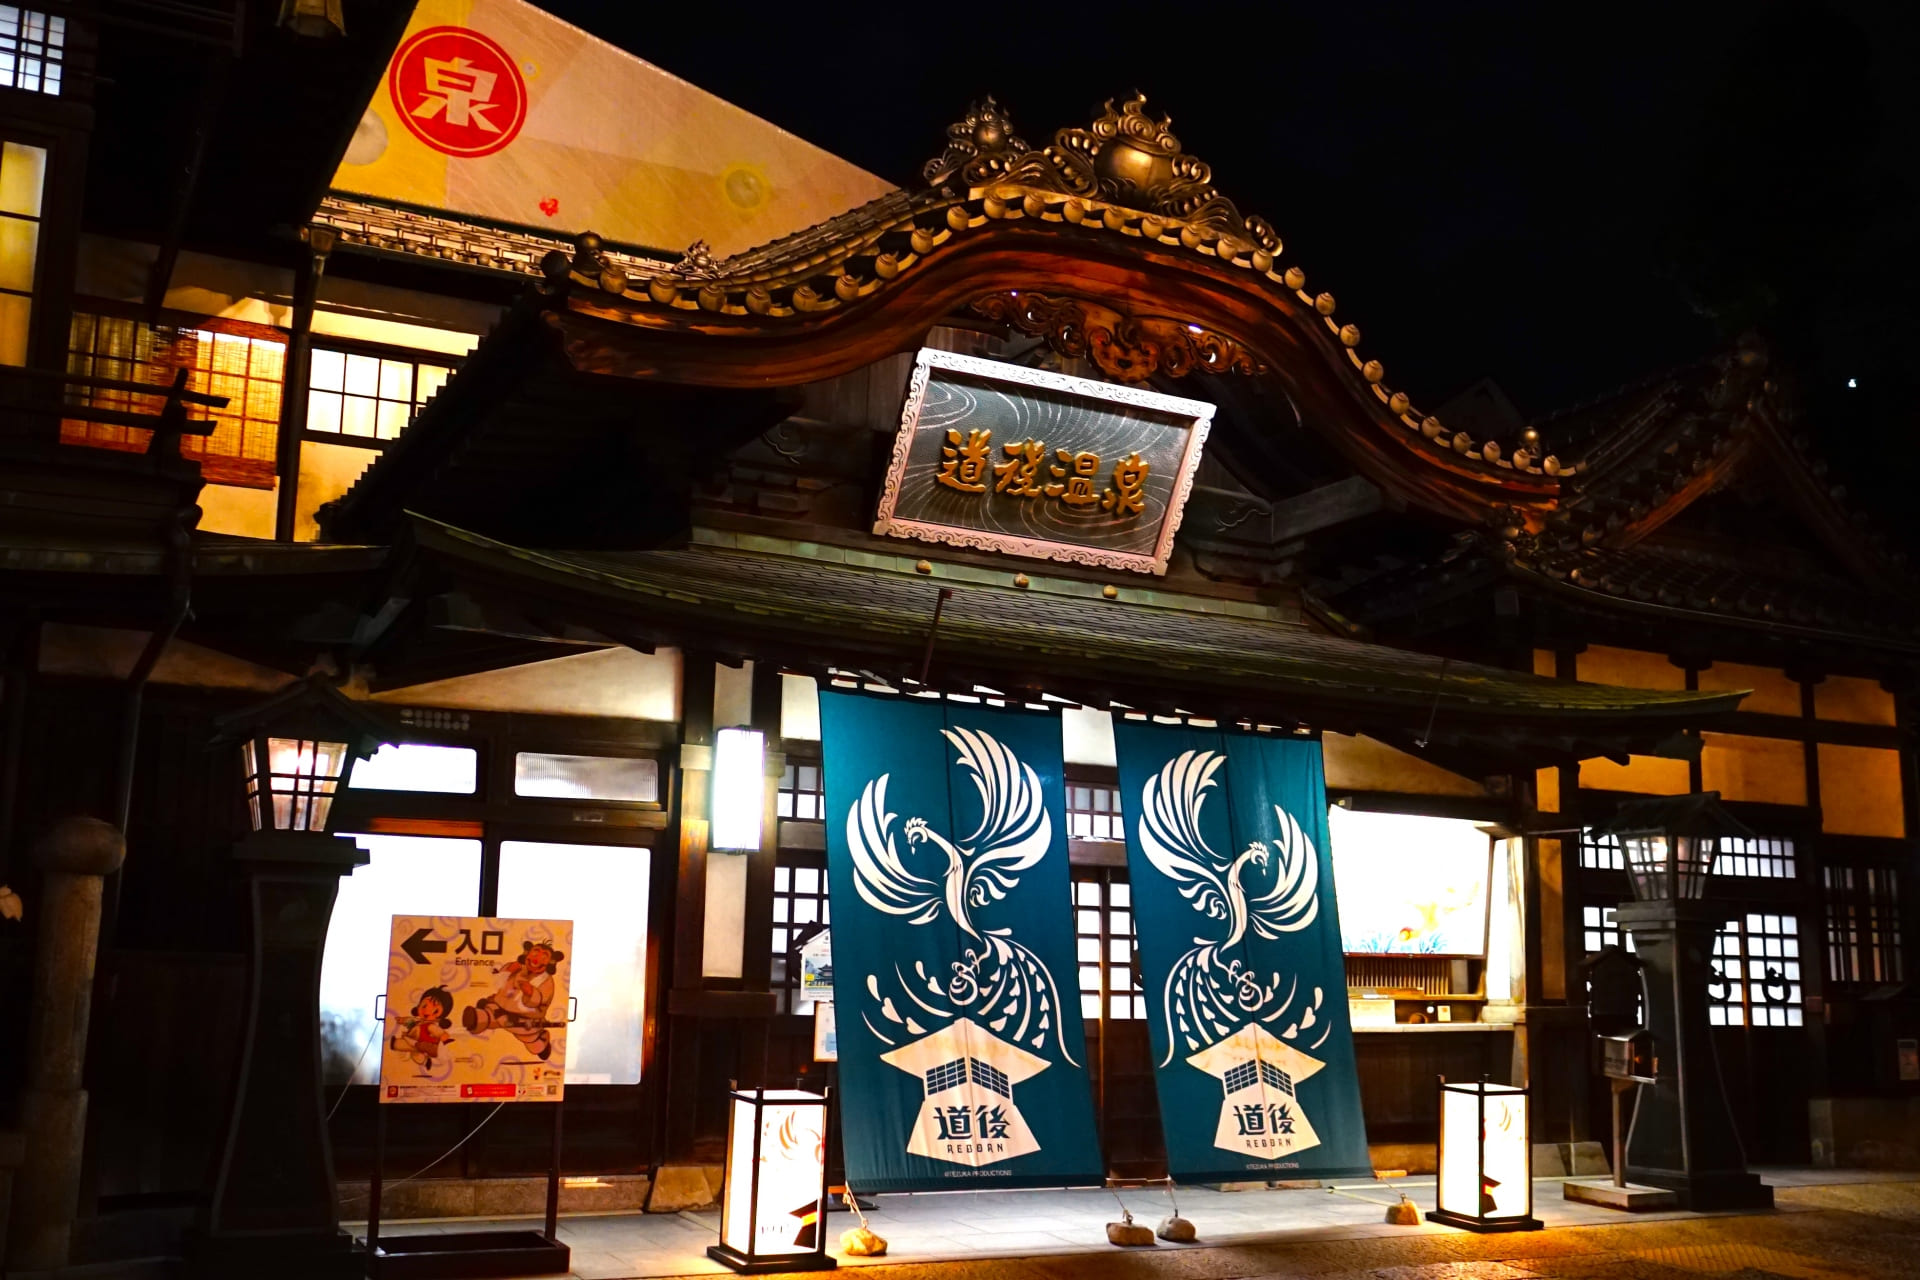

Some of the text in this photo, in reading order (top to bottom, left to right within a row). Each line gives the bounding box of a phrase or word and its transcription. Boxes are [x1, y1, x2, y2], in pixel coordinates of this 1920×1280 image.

[410, 56, 503, 135] 泉
[935, 428, 1149, 515] 道後温泉
[455, 929, 504, 955] 入口
[455, 957, 495, 967] Entrance
[933, 1104, 1011, 1140] 道後
[1233, 1102, 1296, 1136] 道後
[946, 1143, 1004, 1154] REBORN
[1246, 1138, 1292, 1148] REBORN
